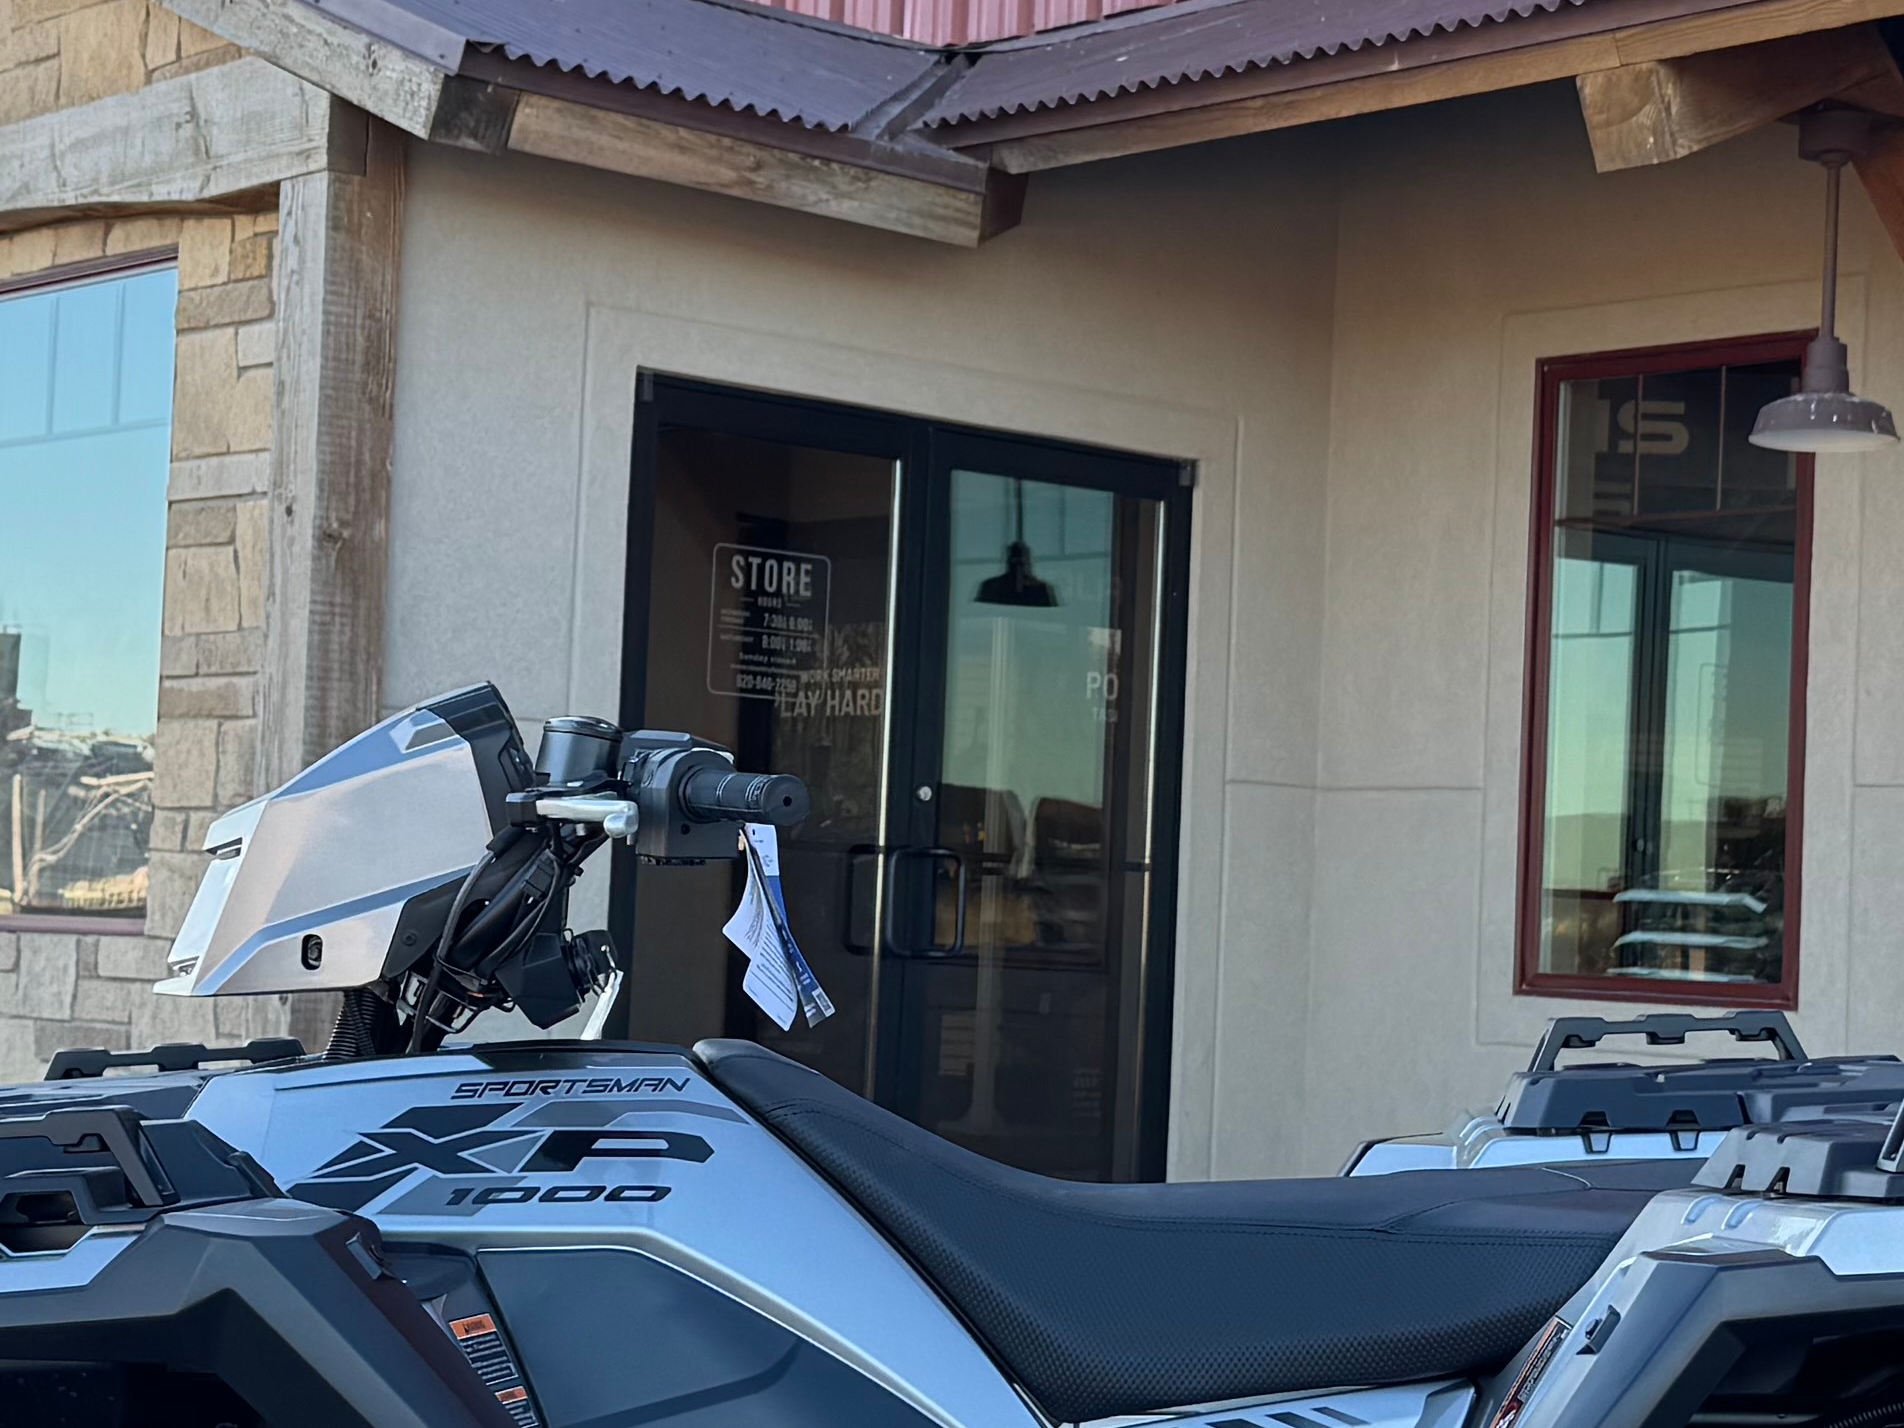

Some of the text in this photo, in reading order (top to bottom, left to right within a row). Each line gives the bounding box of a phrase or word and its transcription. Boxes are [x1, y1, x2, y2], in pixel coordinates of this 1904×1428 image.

[730, 554, 813, 597] STORE
[449, 1076, 691, 1101] SPORTSMAN
[444, 1184, 673, 1206] 1000
